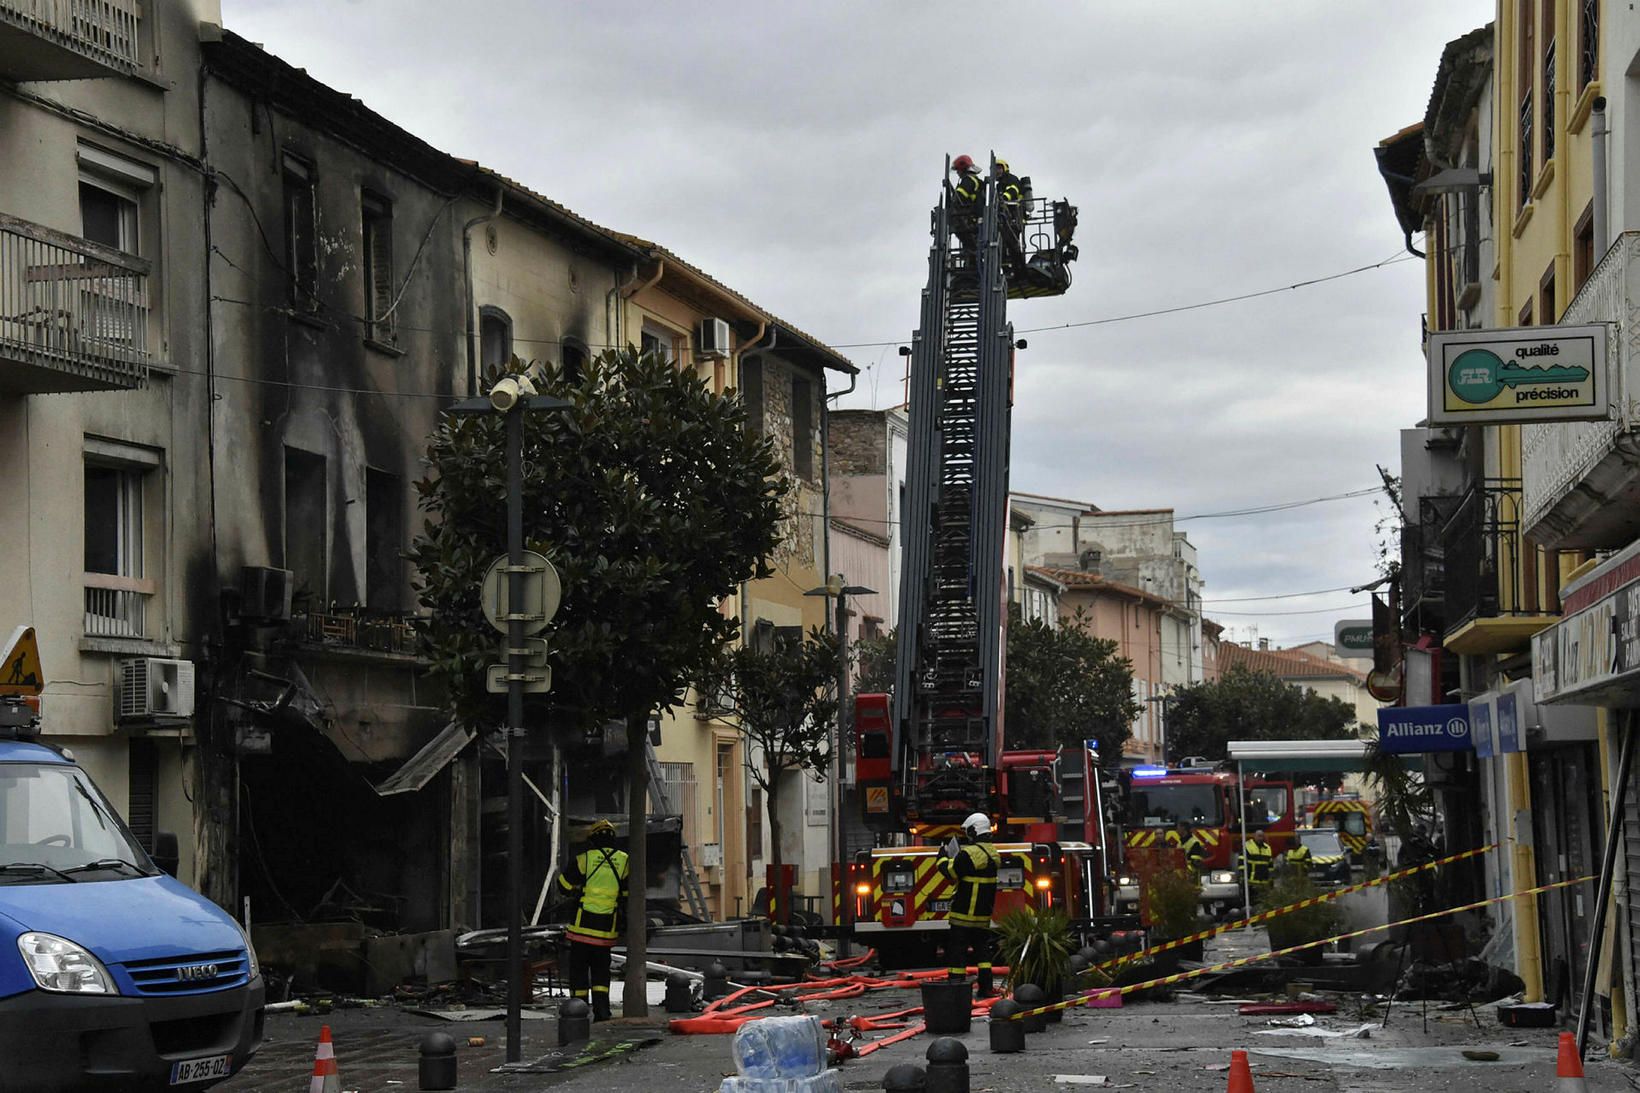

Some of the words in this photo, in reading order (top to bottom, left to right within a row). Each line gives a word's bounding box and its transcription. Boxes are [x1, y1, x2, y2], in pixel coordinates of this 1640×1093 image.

[1515, 343, 1560, 360] qualité
[1515, 386, 1579, 404] précision
[1387, 722, 1444, 737] Allianz
[175, 964, 218, 981] IVECO
